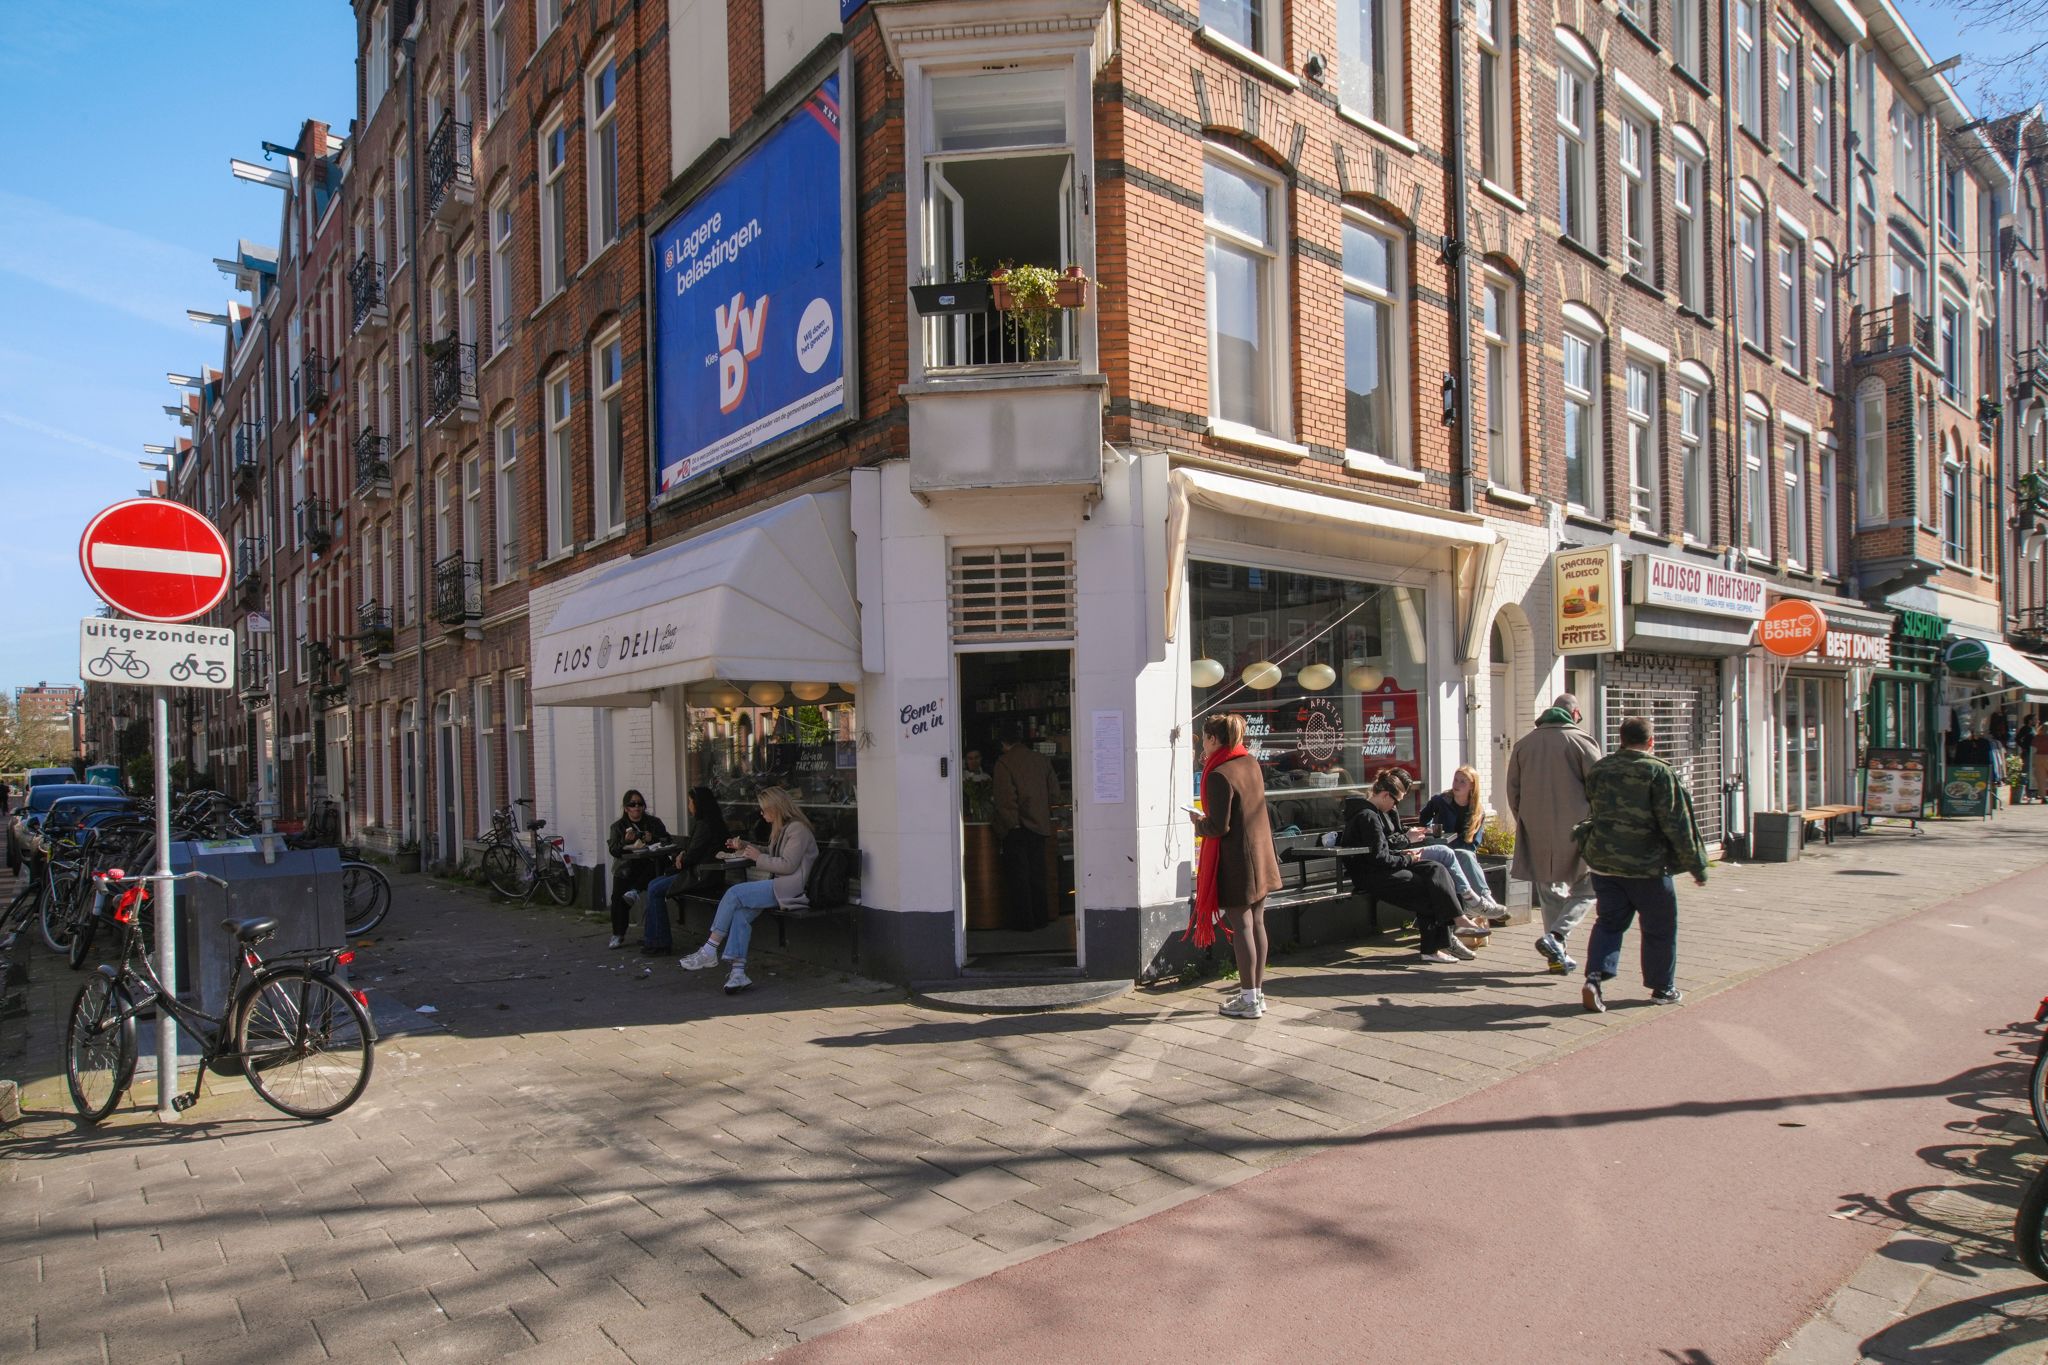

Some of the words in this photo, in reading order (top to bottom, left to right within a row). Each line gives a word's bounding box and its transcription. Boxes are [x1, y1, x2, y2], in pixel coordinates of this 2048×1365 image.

[676, 212, 722, 264] Lagere
[677, 219, 762, 296] belastingen.
[705, 352, 719, 368] Kies
[1560, 558, 1604, 572] SNACKBAR
[1565, 568, 1600, 580] ALDISCO
[1652, 562, 1701, 593] ALDISCO
[1706, 573, 1762, 603] NIGHTSHOP
[1764, 618, 1798, 631] BEST
[86, 623, 229, 646] uitgezonderd
[1561, 629, 1607, 646] FRITES
[1764, 627, 1813, 640] DONER
[619, 627, 659, 660] DELI
[1826, 631, 1853, 659] BEST
[899, 700, 937, 724] Come
[1245, 714, 1264, 725] Fresh
[911, 720, 928, 735] on
[930, 713, 944, 728] in
[1244, 724, 1271, 736] AGELS
[1364, 722, 1391, 734] TREATS
[1361, 744, 1396, 756] TAKEAWAY
